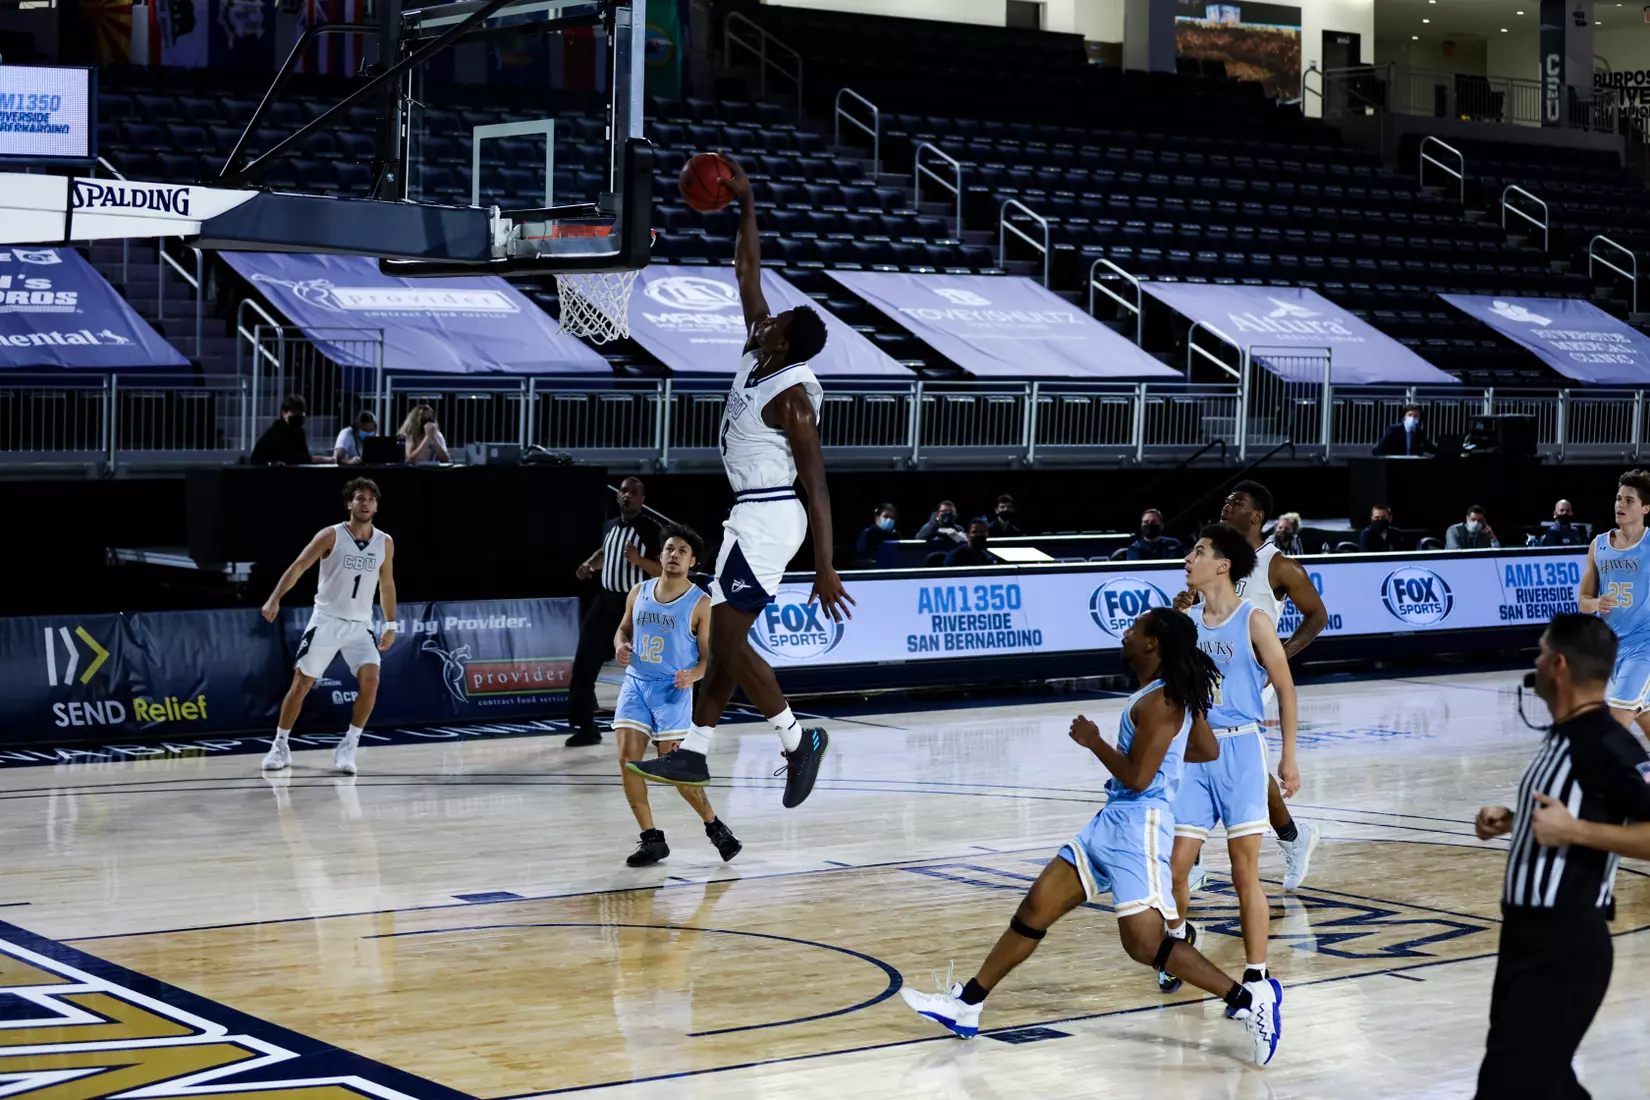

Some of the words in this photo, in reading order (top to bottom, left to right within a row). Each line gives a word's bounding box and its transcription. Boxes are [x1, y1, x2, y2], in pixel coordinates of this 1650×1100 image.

[72, 180, 190, 217] SPALDING
[1227, 312, 1353, 335] Altura
[343, 554, 377, 572] CBU
[1600, 559, 1639, 575] HAWKS
[351, 574, 362, 599] 1
[1505, 562, 1580, 588] AM1350
[918, 584, 1021, 614] AM1350
[1394, 577, 1440, 604] FOX
[1516, 587, 1575, 603] RIVERSIDE
[1608, 582, 1634, 608] 25
[1104, 589, 1153, 618] FOX
[1399, 602, 1443, 615] SPORTS
[1499, 604, 1524, 620] SAN
[412, 619, 438, 635] by
[444, 615, 533, 631] Provider.
[764, 603, 826, 634] FOX
[932, 613, 1012, 632] RIVERSIDE
[640, 635, 665, 663] 12
[769, 633, 829, 647] SPORTS
[907, 634, 940, 653] SAN
[944, 629, 1043, 651] BERNARDINO
[473, 666, 565, 689] provider
[53, 701, 126, 727] SEND
[132, 695, 208, 722] Relief
[478, 697, 515, 707] contract
[517, 695, 537, 705] food
[540, 695, 569, 703] service
